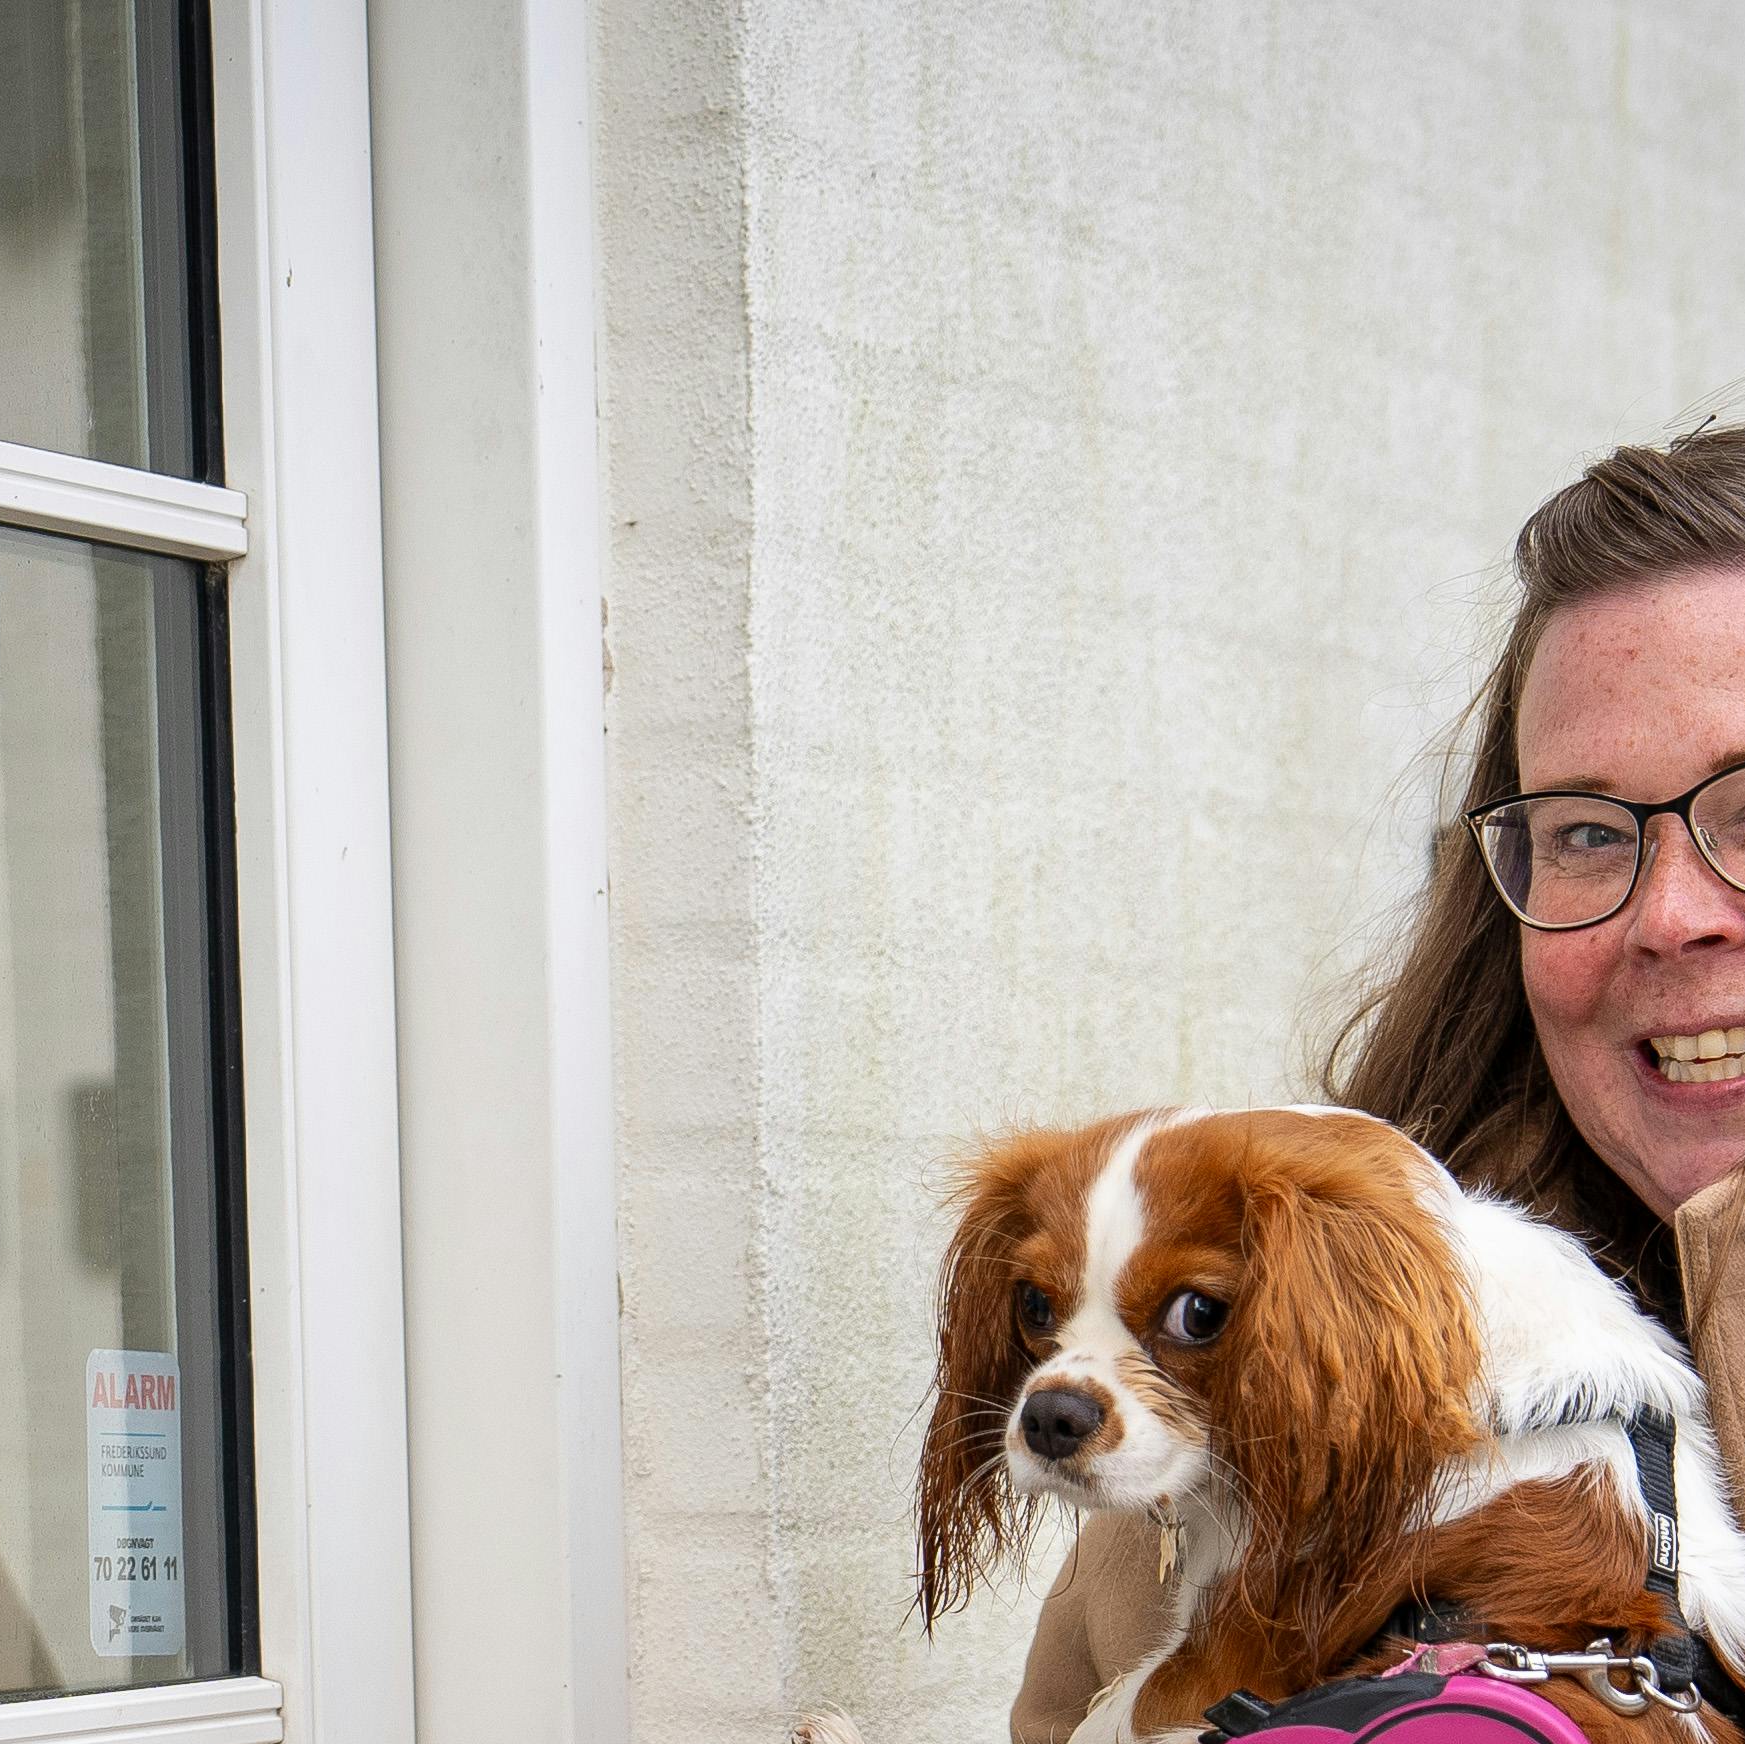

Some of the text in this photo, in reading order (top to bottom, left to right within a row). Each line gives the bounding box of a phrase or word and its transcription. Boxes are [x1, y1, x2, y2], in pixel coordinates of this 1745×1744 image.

[92, 1371, 175, 1411] ALARM
[101, 1445, 167, 1460] FREDERIKSSUND
[101, 1463, 144, 1478] KOMMUNE
[94, 1556, 177, 1581] 70 22 61 11
